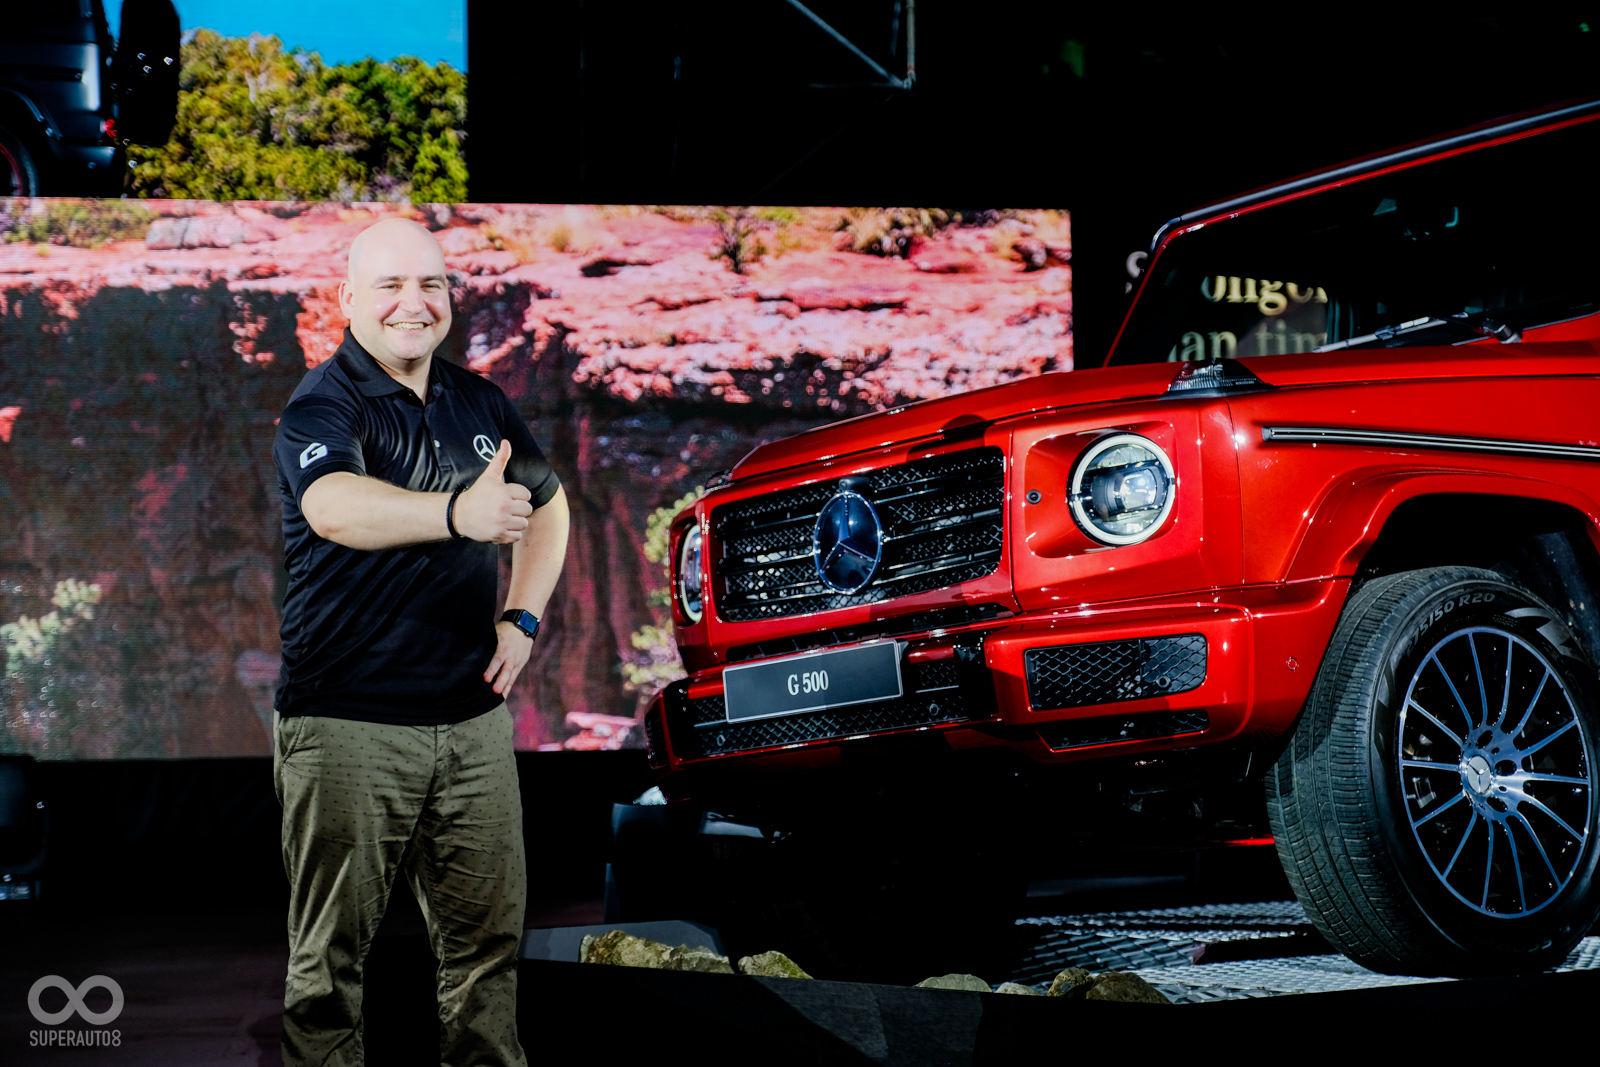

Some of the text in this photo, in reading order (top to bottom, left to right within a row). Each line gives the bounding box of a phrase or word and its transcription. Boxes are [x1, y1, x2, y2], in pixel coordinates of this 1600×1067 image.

[1255, 319, 1328, 355] tim
[300, 443, 328, 469] G
[1458, 592, 1496, 607] R20
[787, 670, 829, 696] G 500
